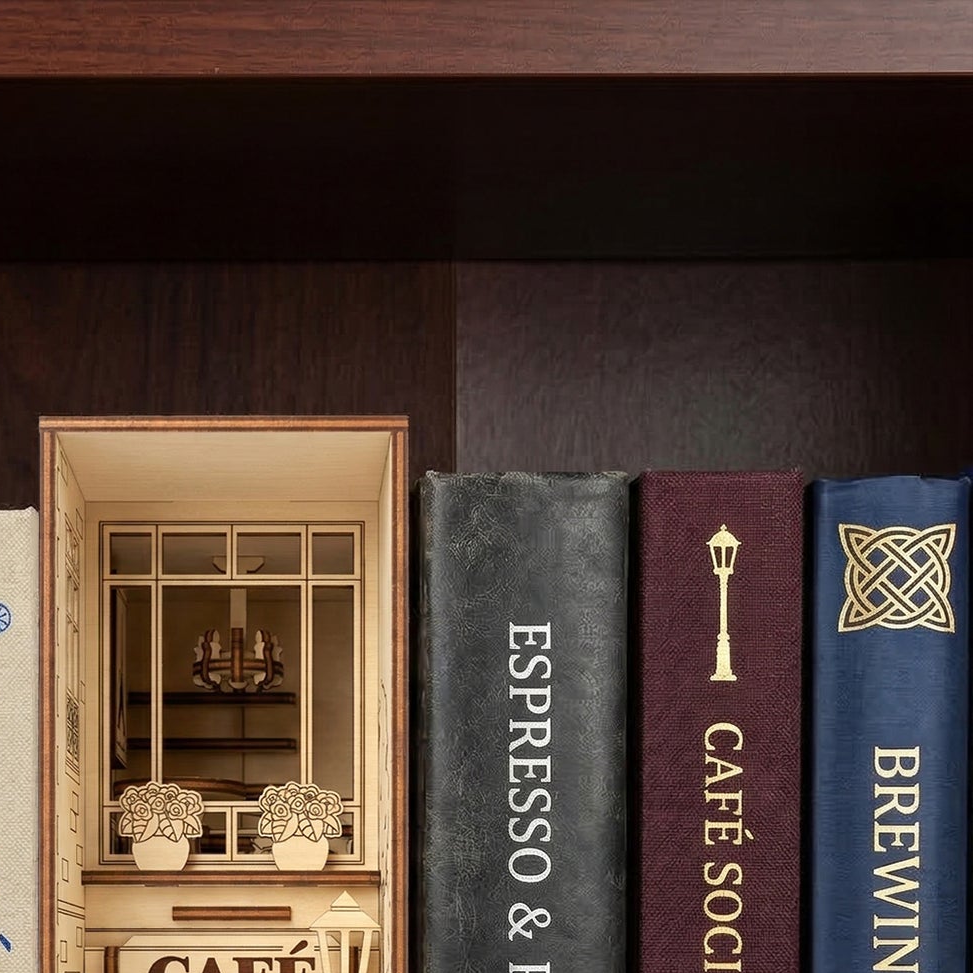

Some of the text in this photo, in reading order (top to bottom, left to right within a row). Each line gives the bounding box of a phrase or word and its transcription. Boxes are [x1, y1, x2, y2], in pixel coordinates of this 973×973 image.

[509, 623, 553, 885] ESPRESSO
[704, 723, 752, 847] CAFÉ
[509, 903, 553, 943] &
